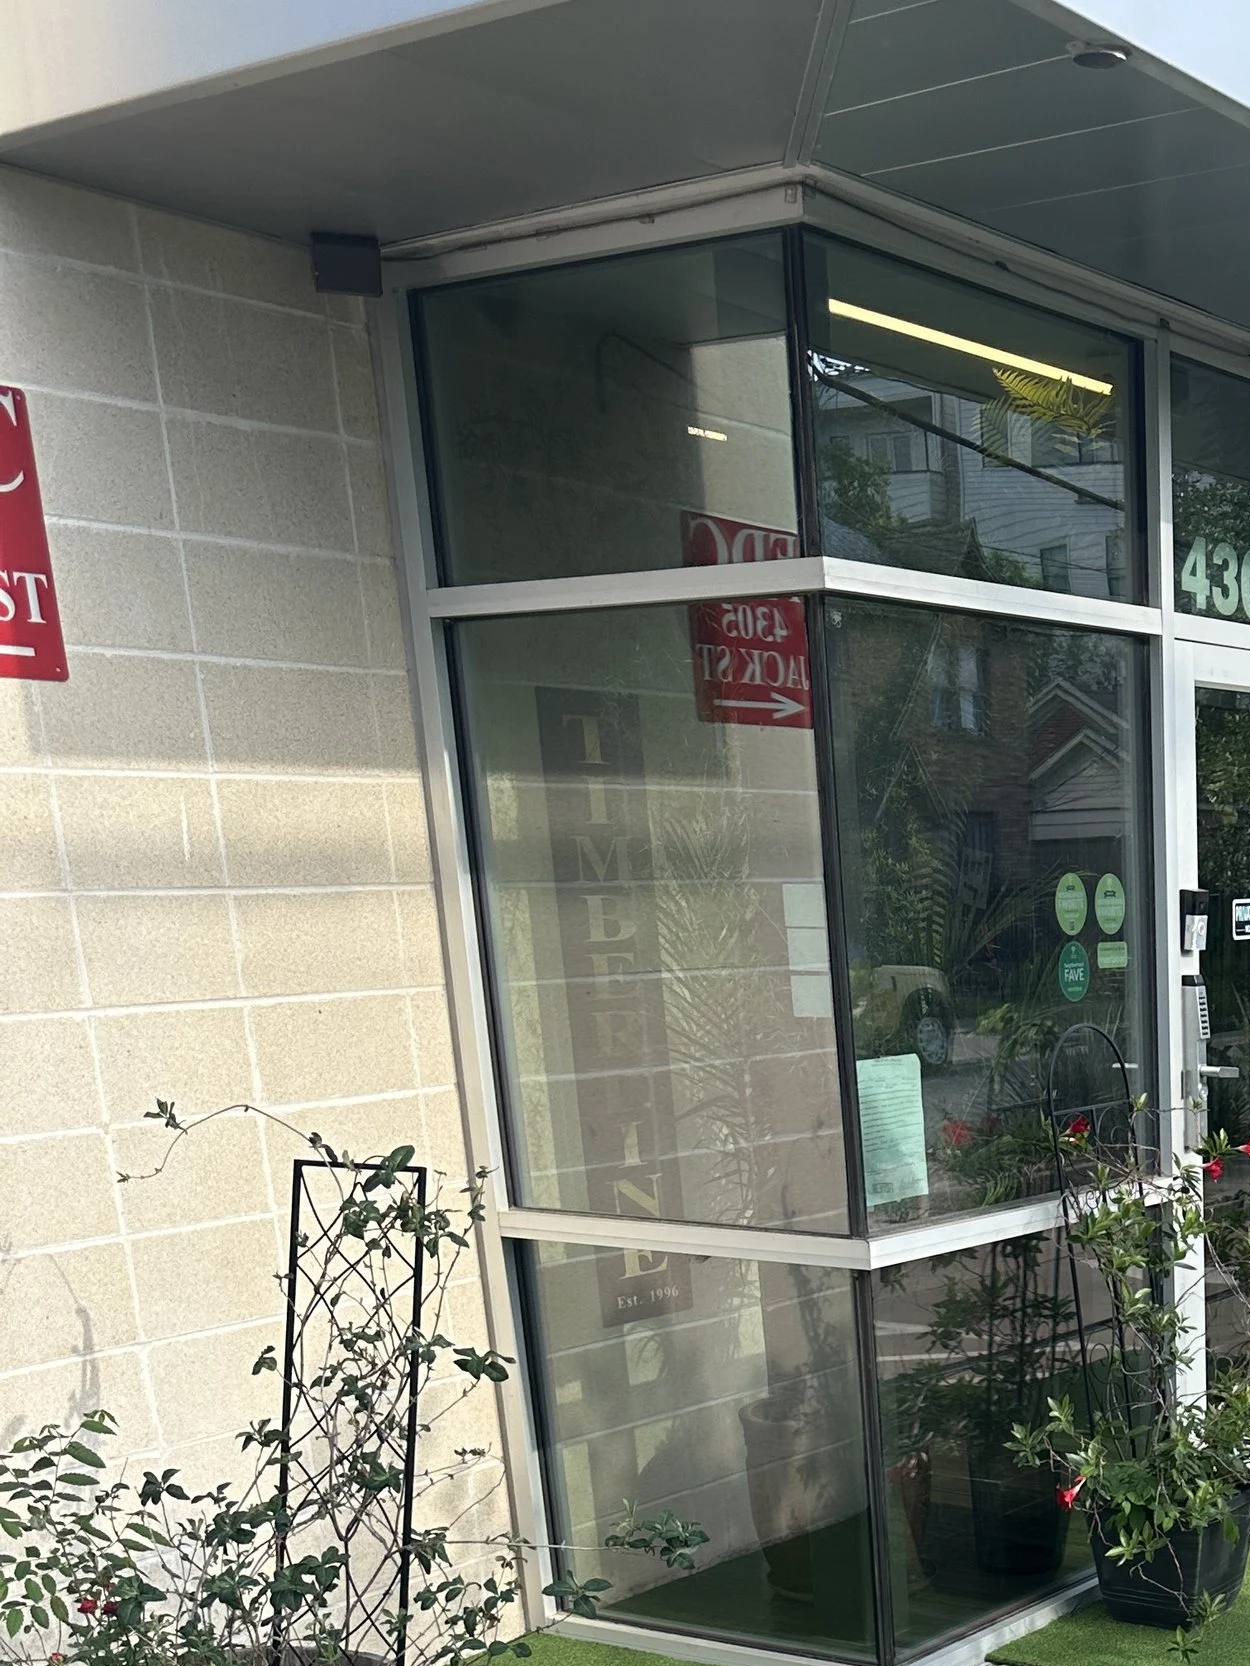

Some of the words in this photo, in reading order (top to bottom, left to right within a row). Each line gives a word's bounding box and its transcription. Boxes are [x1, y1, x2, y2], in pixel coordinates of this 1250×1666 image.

[1064, 968, 1084, 982] FAVE
[617, 1295, 643, 1309] Est.
[650, 1285, 679, 1302] 1996
